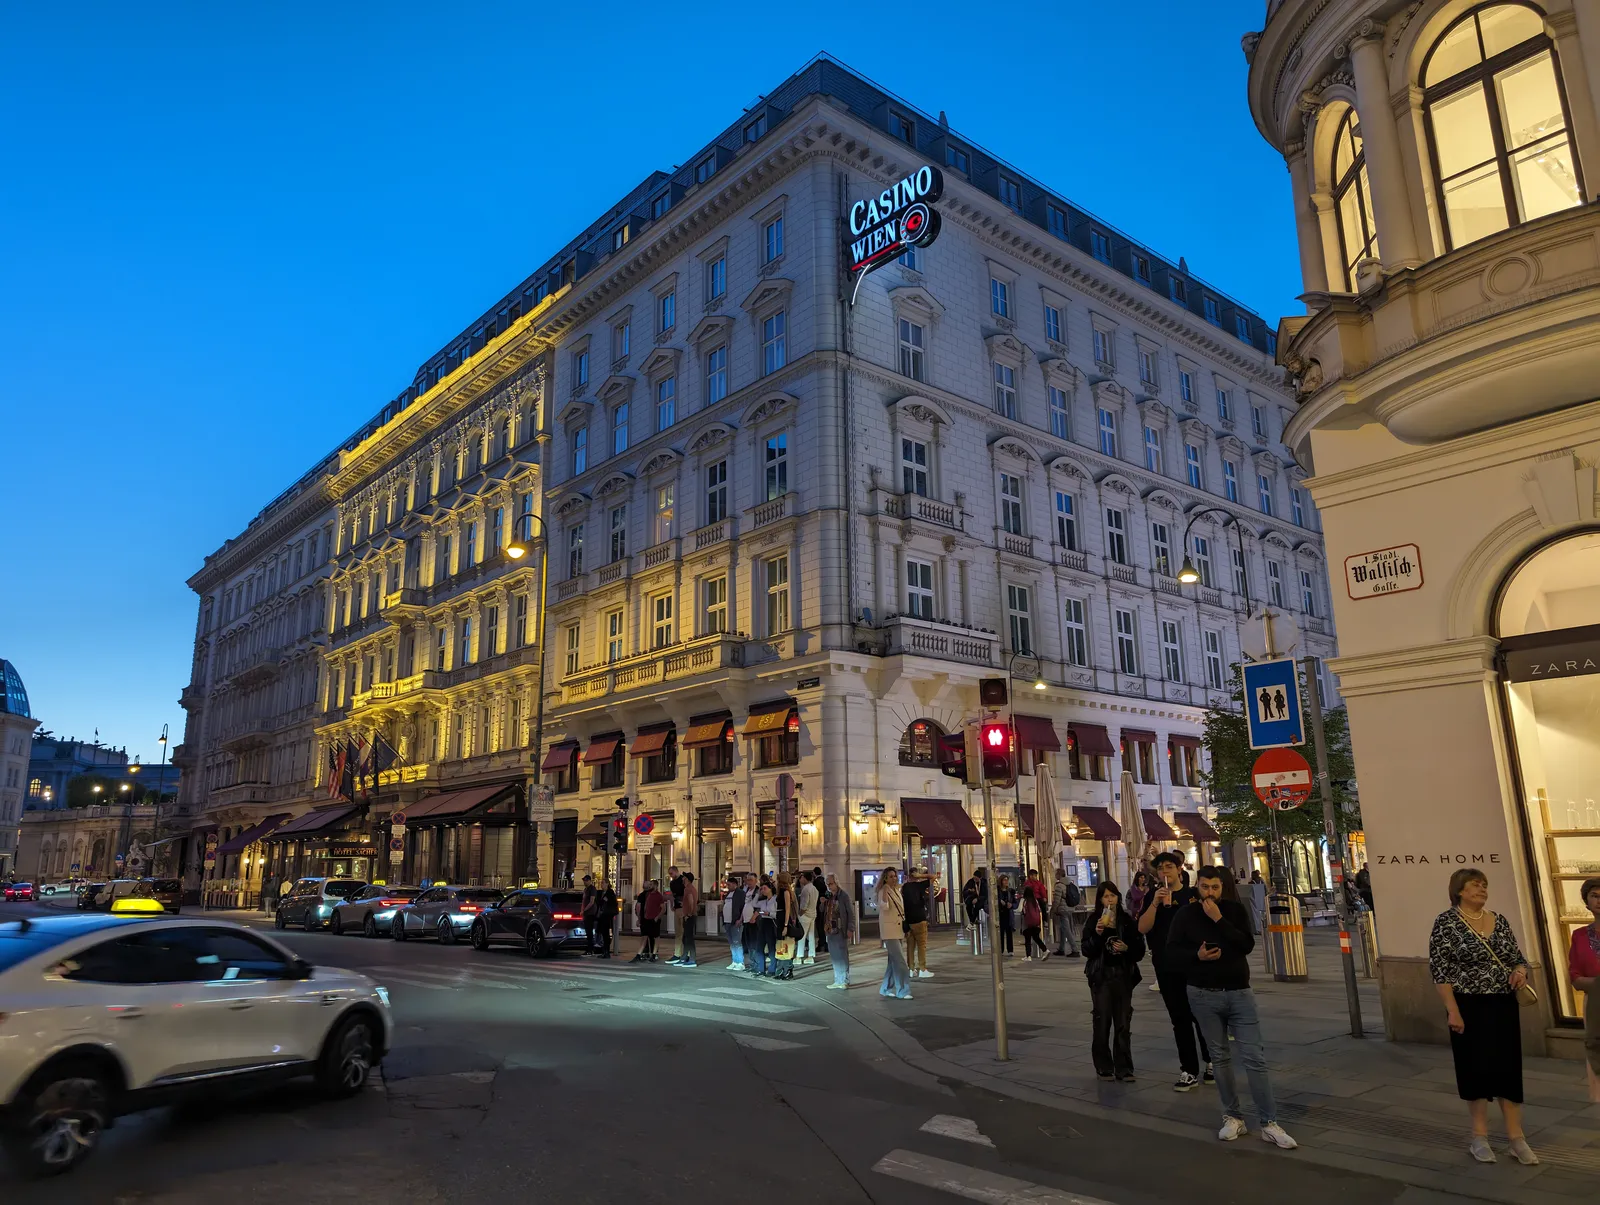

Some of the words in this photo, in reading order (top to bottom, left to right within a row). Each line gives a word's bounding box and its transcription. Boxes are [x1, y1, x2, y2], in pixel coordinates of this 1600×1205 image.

[850, 165, 932, 236] CASINO
[851, 219, 897, 264] WIEN
[1530, 658, 1597, 675] ZARA
[1376, 855, 1430, 865] ZARA
[1440, 853, 1501, 864] HOME
